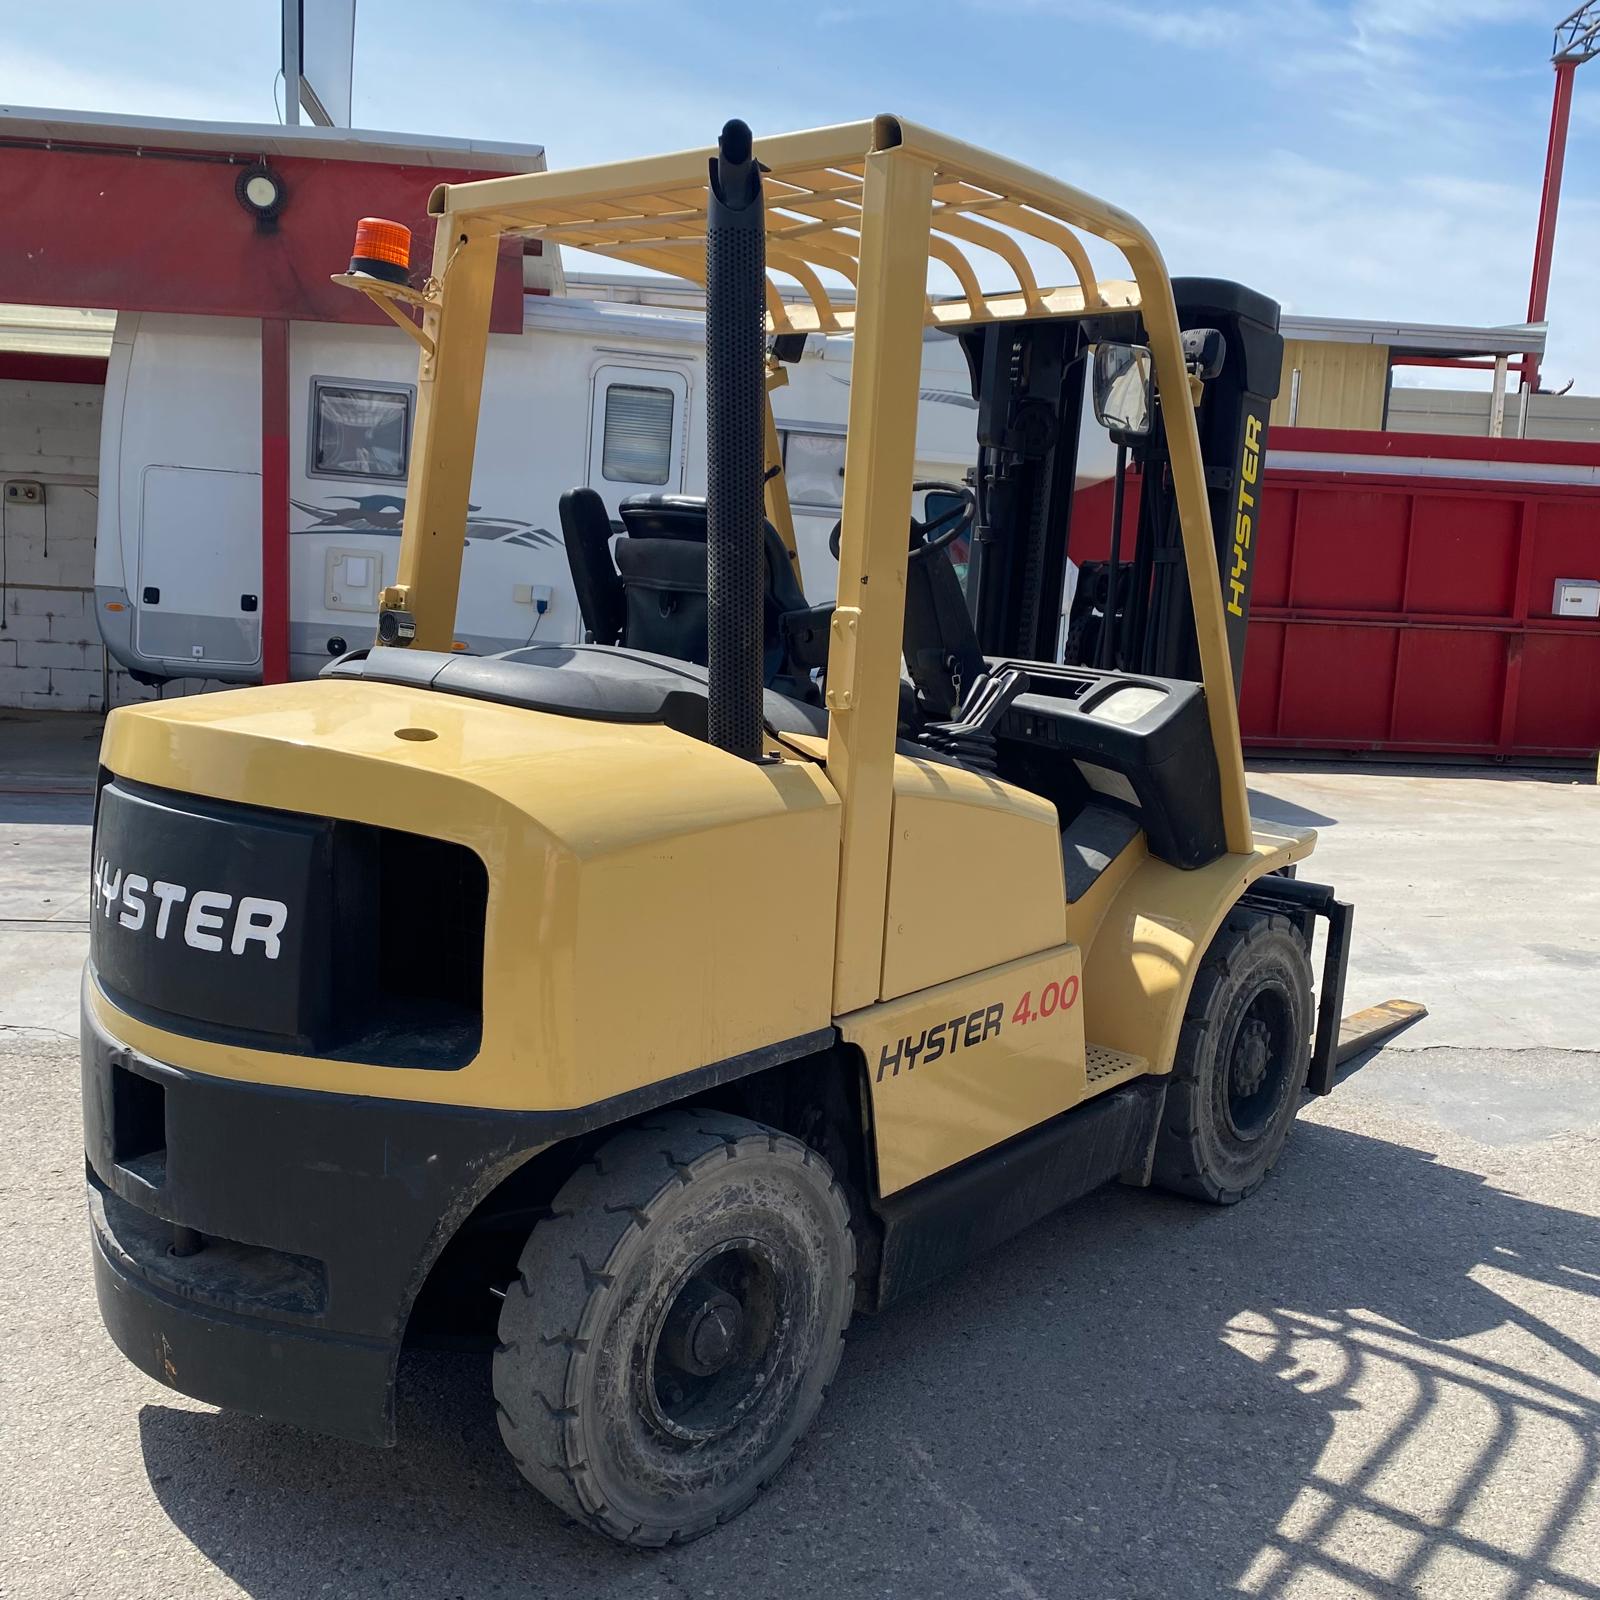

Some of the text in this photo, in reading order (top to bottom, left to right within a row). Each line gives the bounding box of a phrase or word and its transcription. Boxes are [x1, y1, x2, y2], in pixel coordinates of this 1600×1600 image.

[1227, 414, 1262, 617] HYSTER
[876, 975, 1079, 1083] HYSTER 4.00
